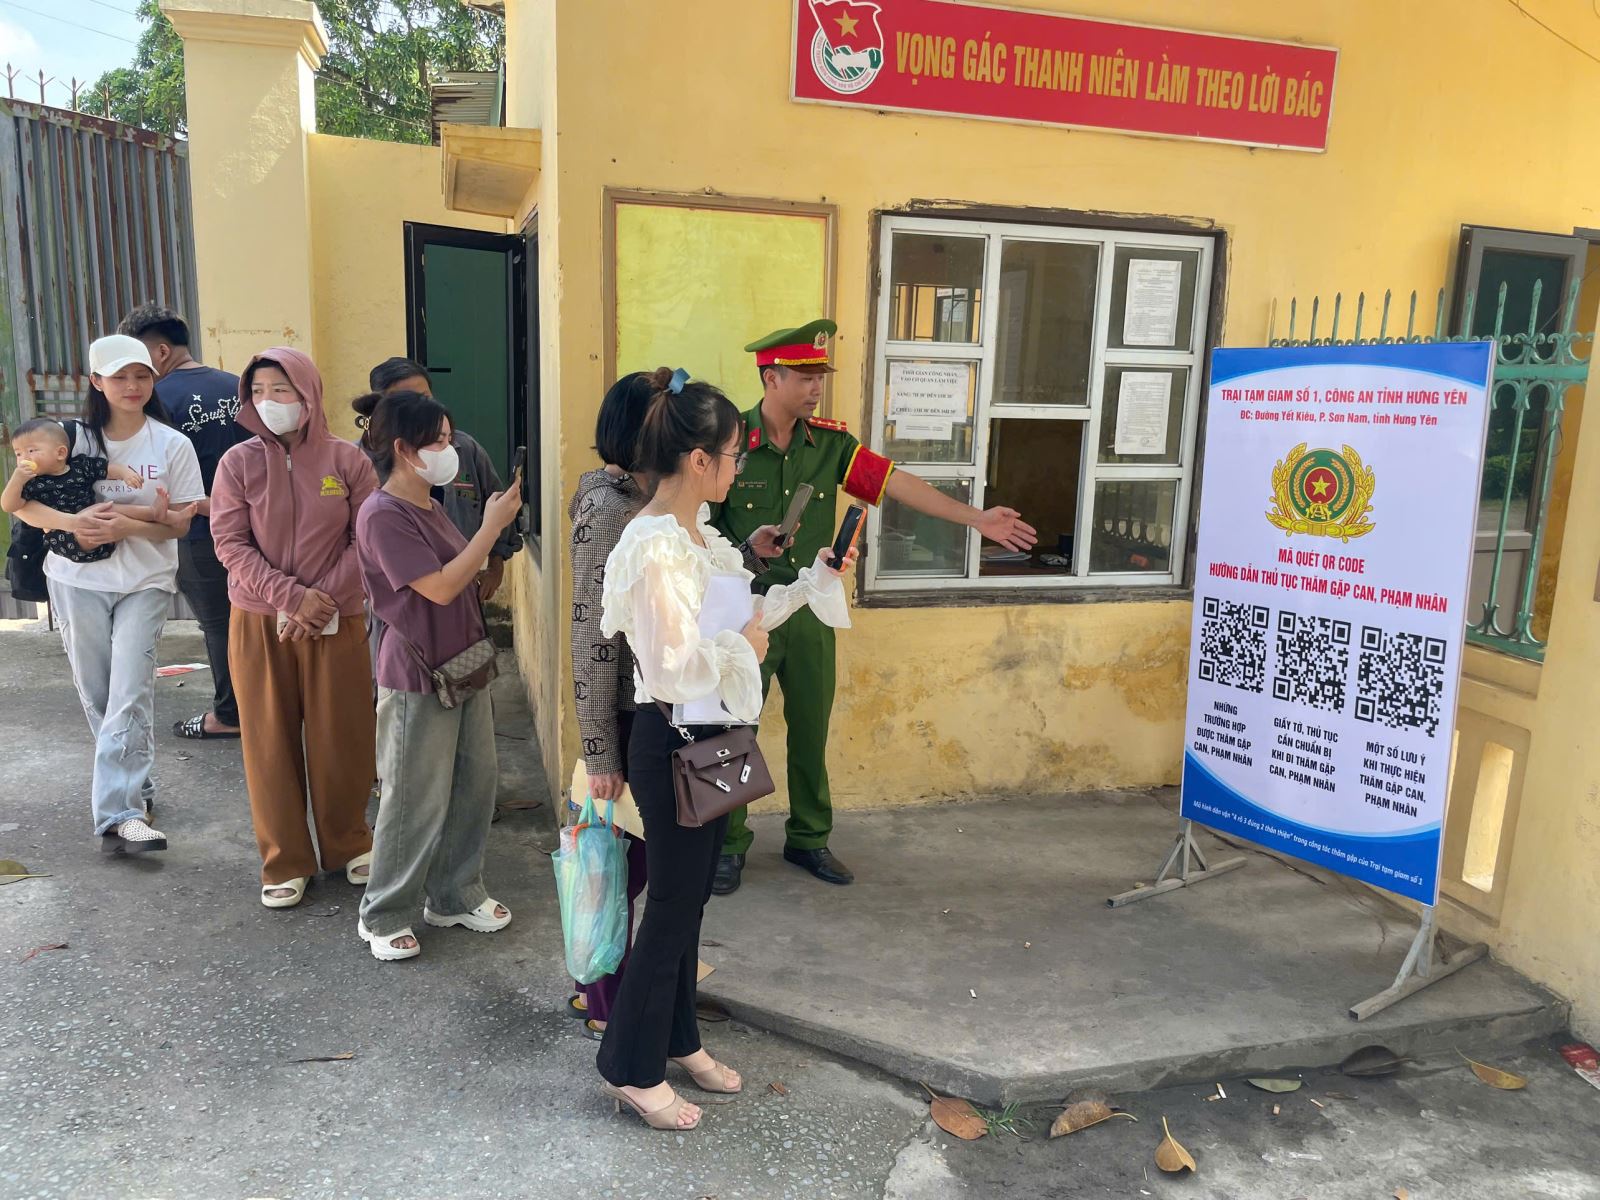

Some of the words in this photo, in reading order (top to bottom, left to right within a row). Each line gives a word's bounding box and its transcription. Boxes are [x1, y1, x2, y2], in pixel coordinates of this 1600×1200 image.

[896, 31, 956, 85] VỌNG
[962, 31, 1007, 84] GÁC
[1013, 45, 1084, 93] THANH
[1088, 48, 1139, 99] NIÊN
[1145, 53, 1190, 104] LÀM
[1196, 67, 1244, 110] THEO
[1248, 65, 1281, 114] LỜI
[1283, 70, 1324, 118] BÁC
[1221, 389, 1242, 404] TRẠI
[1244, 389, 1264, 404] TẠM
[1268, 390, 1293, 402] GIAM
[1296, 386, 1310, 402] SỐ
[1325, 388, 1354, 403] CÔNG
[1358, 390, 1374, 403] AN
[1377, 386, 1404, 404] TỈNH
[1406, 390, 1440, 404] HƯNG
[1444, 388, 1468, 405] YÊN
[1240, 410, 1253, 420] ĐC:
[1255, 410, 1279, 422] Đường
[1282, 410, 1294, 421] Yết
[1319, 412, 1326, 422] P.
[1328, 412, 1345, 423] Sơn
[1347, 412, 1370, 424] Nam,
[1373, 412, 1390, 424] tỉnh
[1393, 414, 1416, 426] Hưng
[1420, 414, 1437, 425] Yên
[100, 485, 132, 493] PARIS
[1278, 547, 1293, 564] MÃ
[1296, 550, 1320, 567] QUÉT
[1322, 554, 1335, 570] QR
[1338, 556, 1365, 574] CODE
[1209, 562, 1238, 579] HƯỚNG
[1241, 563, 1259, 583] DẪN
[1262, 567, 1278, 586] THỦ
[1281, 573, 1298, 591] TỤC
[1301, 576, 1328, 594] THĂM
[1330, 579, 1350, 599] GẶP
[1353, 584, 1377, 603] CAN,
[1381, 588, 1412, 608] PHẠM
[1415, 593, 1448, 613] NHÂN
[1204, 714, 1230, 729] TRƯỜNG
[1232, 722, 1246, 734] HỢP
[1274, 717, 1291, 730] GIẤY
[1293, 722, 1304, 735] TỜ,
[1306, 725, 1321, 738] THỦ
[1323, 730, 1338, 743] TỤC
[1197, 727, 1215, 740] ĐƯỢC
[1216, 732, 1235, 746] THĂM
[1237, 738, 1251, 751] GẶP
[1295, 741, 1322, 755] CHUẨN
[1324, 747, 1332, 760] BỊ
[1194, 741, 1209, 755] CAN,
[1211, 746, 1231, 760] PHẠM
[1233, 752, 1252, 767] NHÂN
[1272, 749, 1284, 761] KHI
[1286, 753, 1294, 763] ĐI
[1296, 756, 1318, 770] THĂM
[1320, 762, 1336, 776] GẶP
[1366, 741, 1385, 756] MỘT
[1387, 745, 1399, 759] SỐ
[1401, 750, 1418, 764] LƯU
[1420, 754, 1426, 766] Ý
[1269, 764, 1286, 779] CAN,
[1289, 770, 1311, 785] PHẠM
[1313, 777, 1336, 792] NHÂN
[1363, 758, 1378, 771] KHI
[1380, 762, 1402, 778] THỰC
[1404, 769, 1426, 784] HIỆN
[1360, 774, 1383, 790] THĂM
[1386, 782, 1403, 796] GẶP
[1405, 787, 1426, 803] CAN,
[1365, 793, 1390, 809] PHẠM
[1392, 801, 1417, 817] NHÂN
[1294, 835, 1308, 847] trong
[1308, 840, 1321, 851] công
[1346, 853, 1357, 864] gặp
[1358, 857, 1369, 866] của
[1369, 860, 1381, 870] Trại
[1381, 865, 1393, 875] tạm
[1394, 870, 1409, 881] giam
[1410, 875, 1418, 884] số
[1418, 877, 1423, 885] 1
